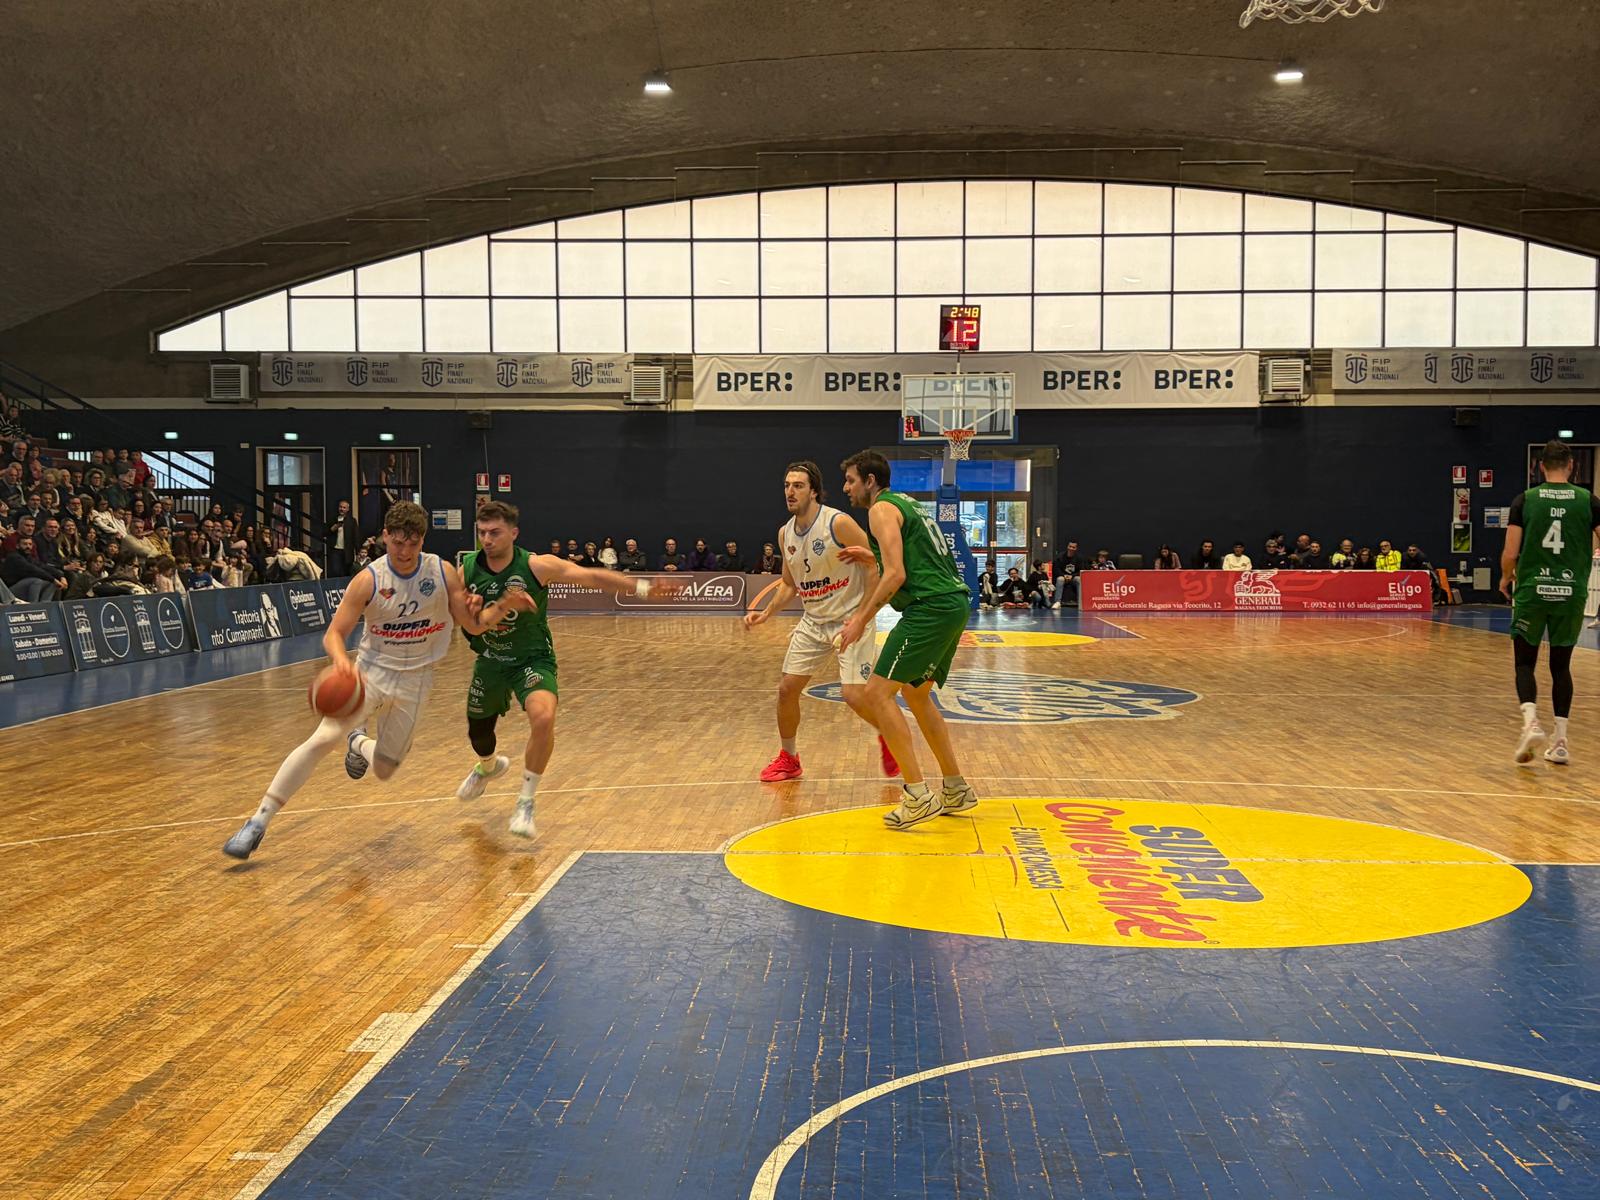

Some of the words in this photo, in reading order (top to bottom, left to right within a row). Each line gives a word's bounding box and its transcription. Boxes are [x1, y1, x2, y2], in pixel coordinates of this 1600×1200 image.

[951, 307, 979, 318] 2:48
[953, 320, 977, 342] 12
[1550, 507, 1567, 518] DIP
[1541, 519, 1565, 555] 4
[803, 558, 811, 573] 5
[1103, 582, 1136, 596] Eligo
[1388, 582, 1422, 597] Eligo
[1092, 602, 1118, 610] Agenzia
[1148, 602, 1172, 610] Ragusa
[1235, 596, 1281, 605] GENERALI
[397, 600, 419, 618] 22
[232, 610, 260, 625] Trattoria
[1017, 846, 1065, 889] PROMESSA
[1128, 824, 1265, 903] SUPER
[1044, 802, 1217, 942] Conveniente
